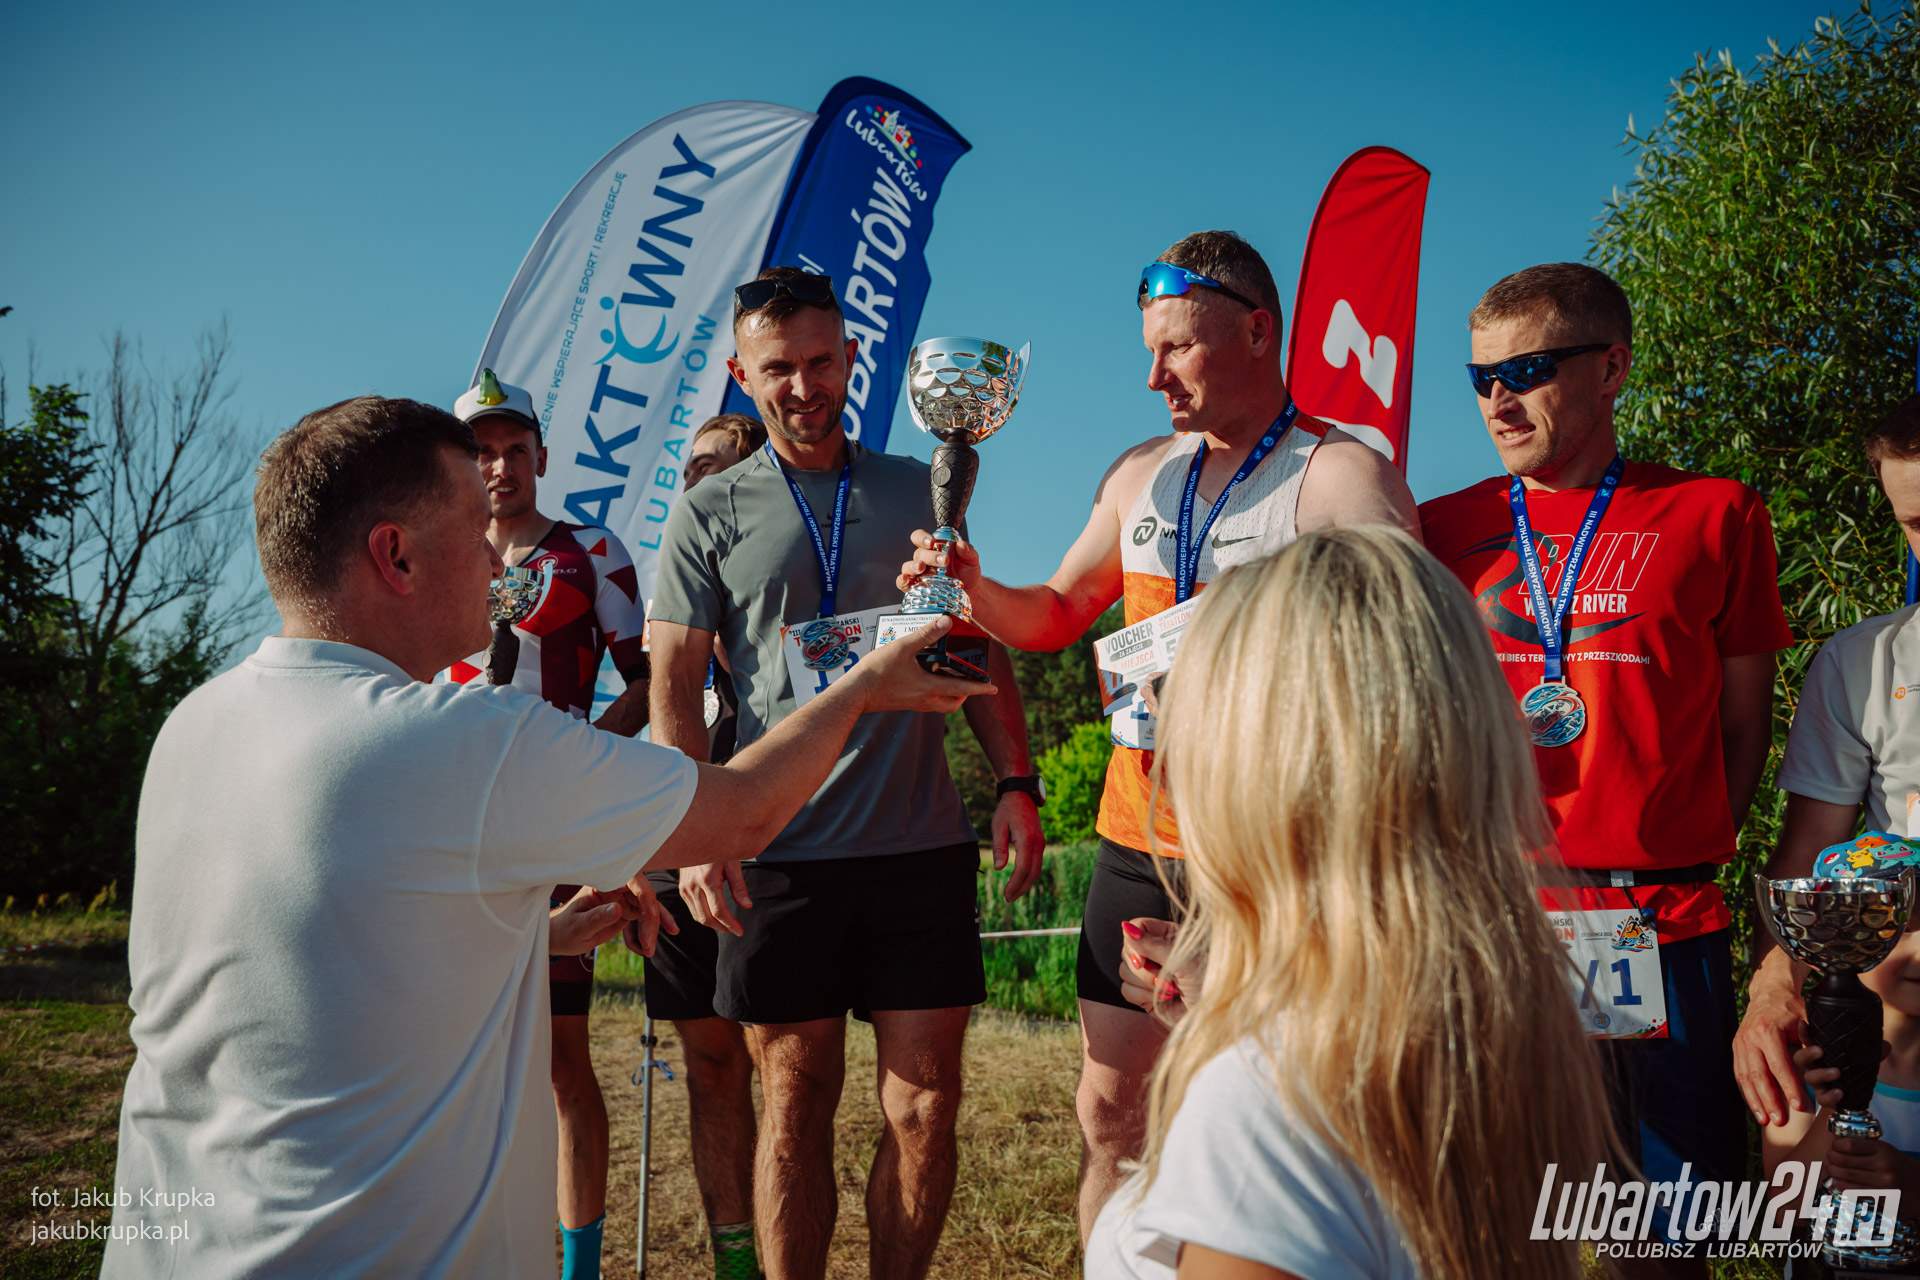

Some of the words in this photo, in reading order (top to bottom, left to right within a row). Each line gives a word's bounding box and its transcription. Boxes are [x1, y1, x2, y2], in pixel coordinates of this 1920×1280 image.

[579, 251, 599, 294] SPORT
[594, 171, 628, 244] REKREACJĘ
[639, 314, 718, 551] LUBARTÓW
[1589, 510, 1598, 519] III
[1178, 511, 1191, 587] NADWIEPRZAŃSKI
[1517, 515, 1533, 557] TRIATHLON
[1561, 519, 1594, 593] NADWIEPRZAŃSKI
[1178, 586, 1186, 598] III
[1525, 557, 1554, 638] NADWIEPRZAŃSKI
[1582, 593, 1628, 614] RIVER
[1104, 622, 1154, 655] VOUCHER
[1546, 639, 1555, 648] III
[1506, 652, 1526, 662] BIEG
[1583, 652, 1650, 664] PRZESZKODAMI
